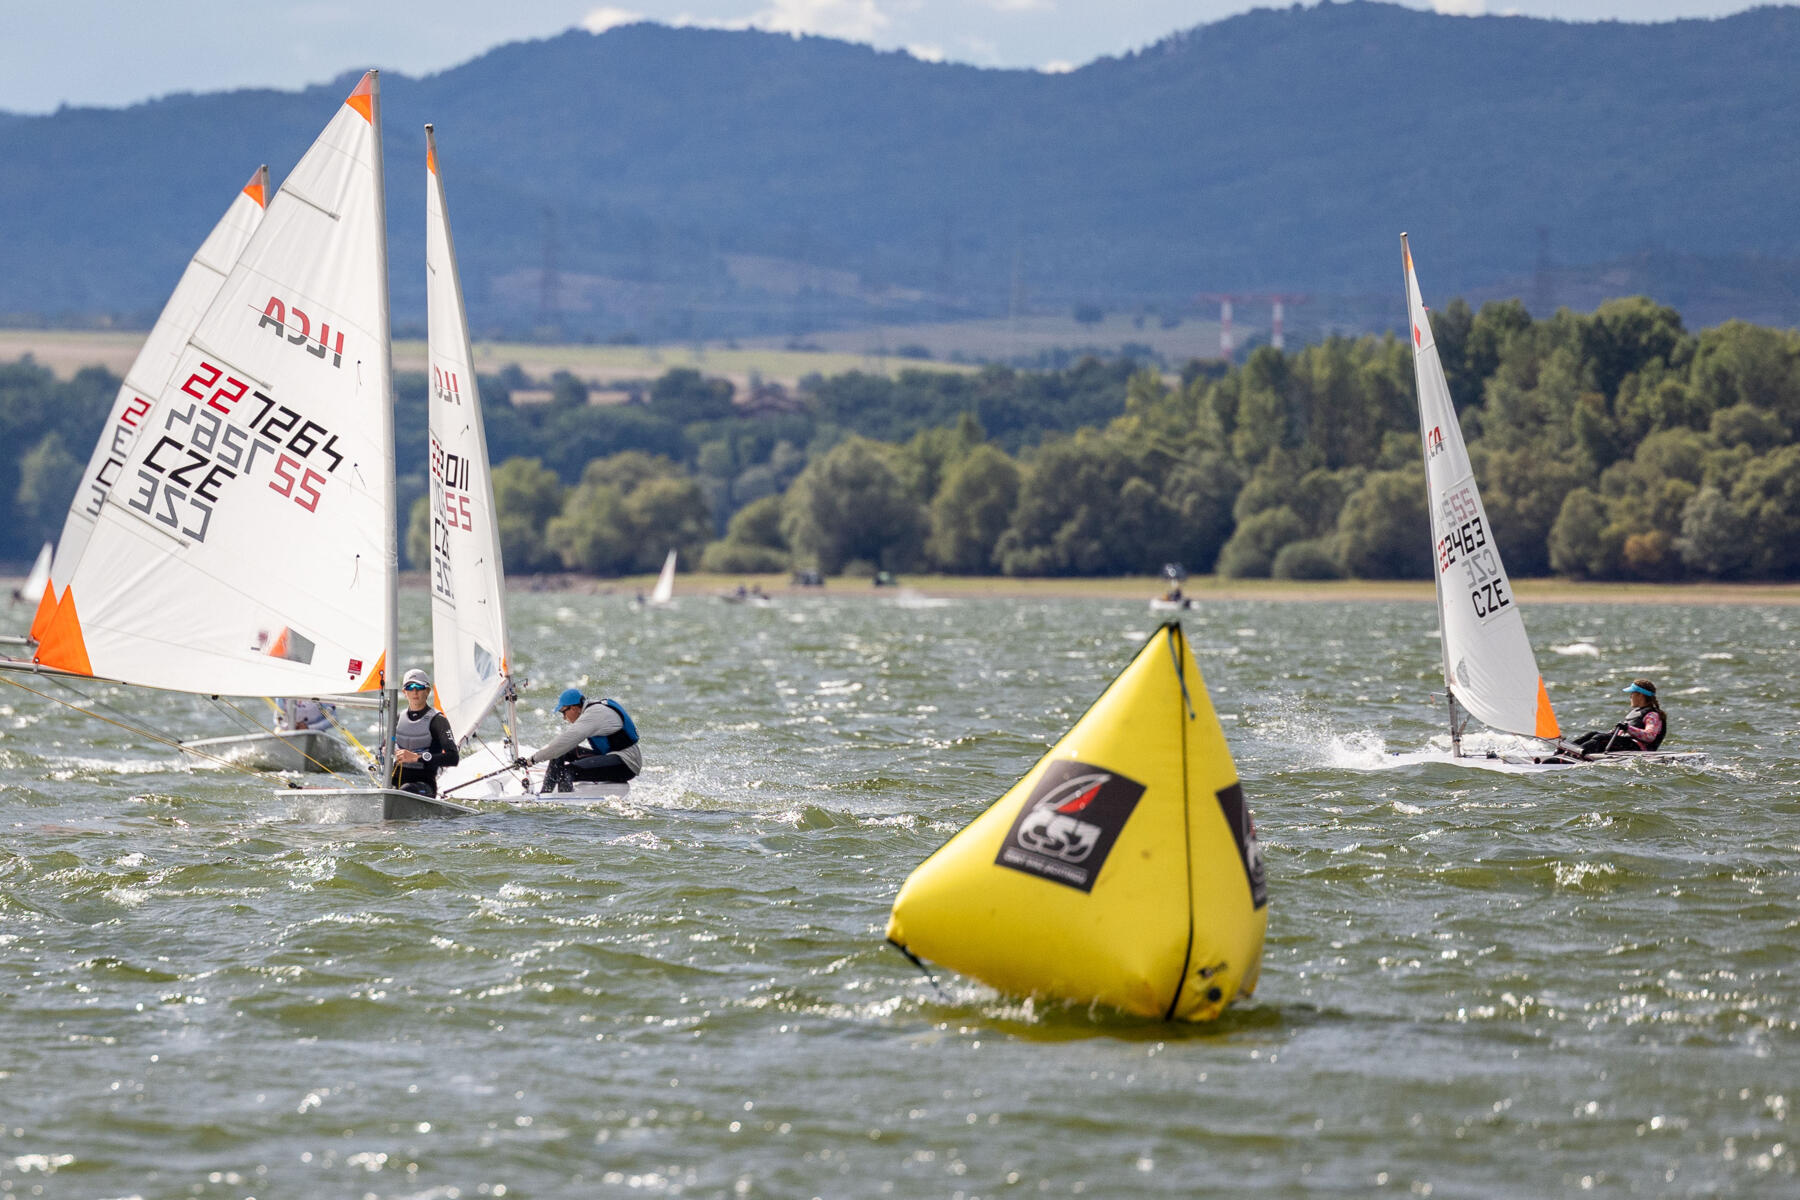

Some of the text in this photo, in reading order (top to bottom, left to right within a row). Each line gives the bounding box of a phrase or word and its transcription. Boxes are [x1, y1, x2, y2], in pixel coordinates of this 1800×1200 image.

[181, 361, 344, 473] 227264
[142, 435, 237, 504] CZE
[1472, 578, 1510, 618] CZE
